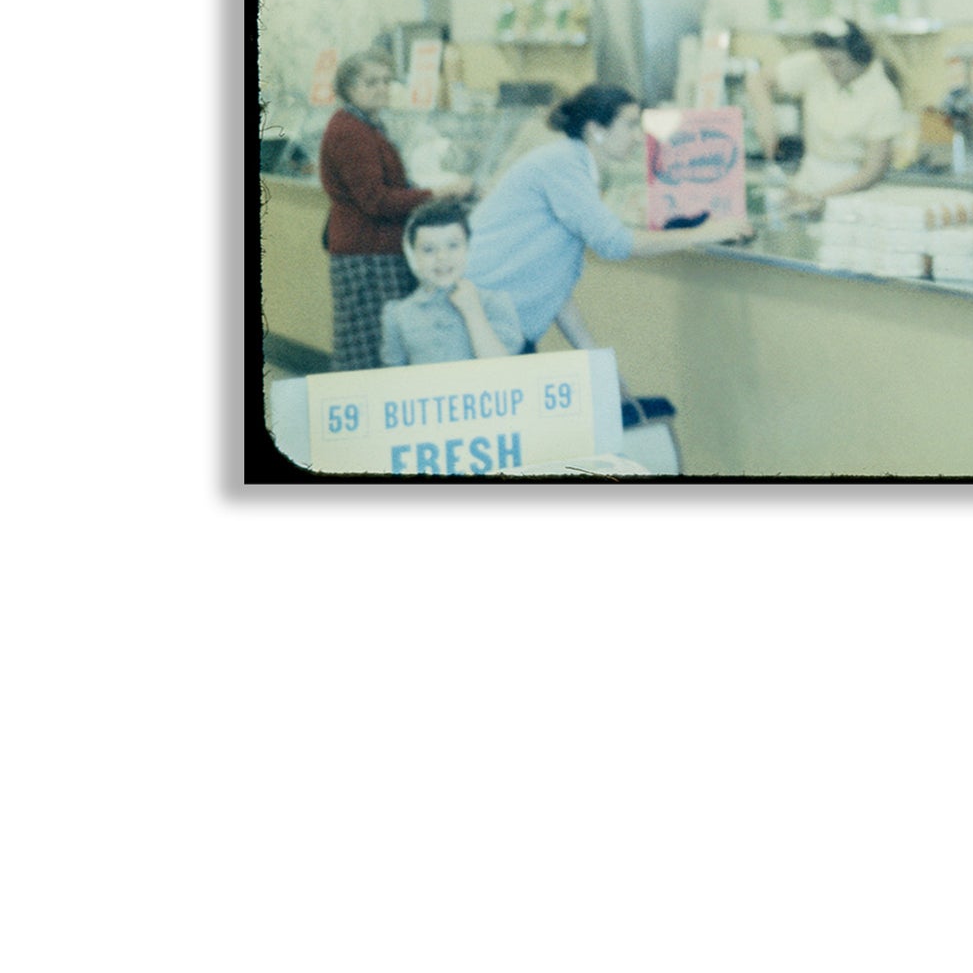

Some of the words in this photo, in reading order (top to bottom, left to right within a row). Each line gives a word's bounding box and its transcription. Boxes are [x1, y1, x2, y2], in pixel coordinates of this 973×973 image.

[328, 403, 361, 434] 59
[384, 388, 525, 430] BUTTERCUP
[544, 382, 573, 411] 59
[390, 432, 523, 474] FRESH
